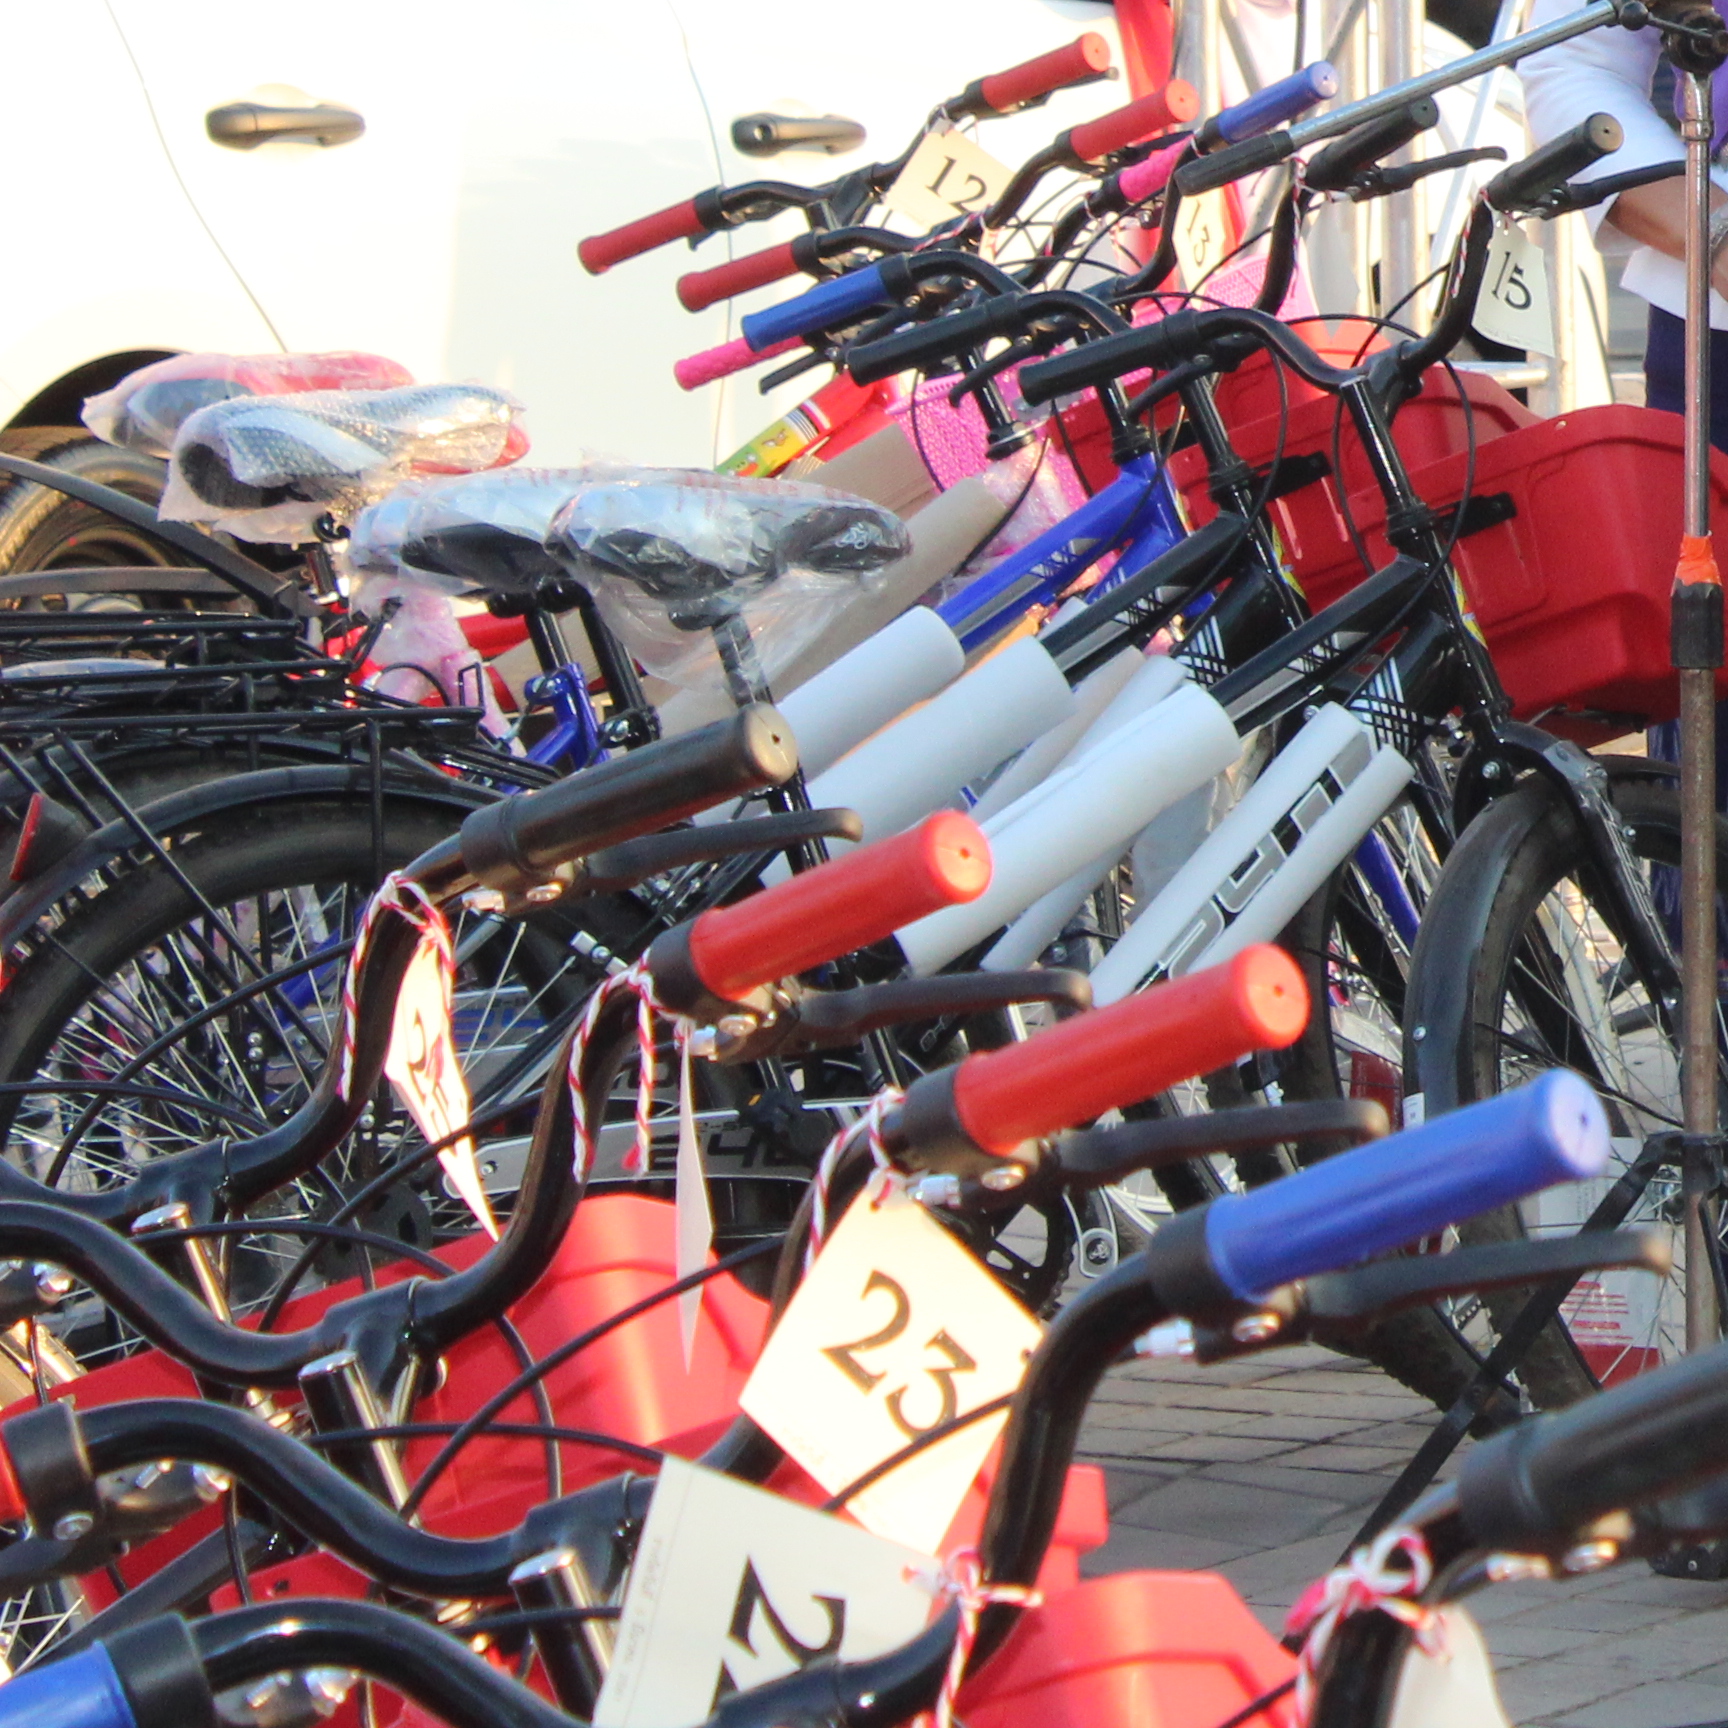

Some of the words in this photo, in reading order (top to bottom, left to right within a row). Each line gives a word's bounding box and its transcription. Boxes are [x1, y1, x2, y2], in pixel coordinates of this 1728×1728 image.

[926, 155, 988, 215] 12
[1491, 251, 1531, 310] 15
[820, 1269, 978, 1441] 23
